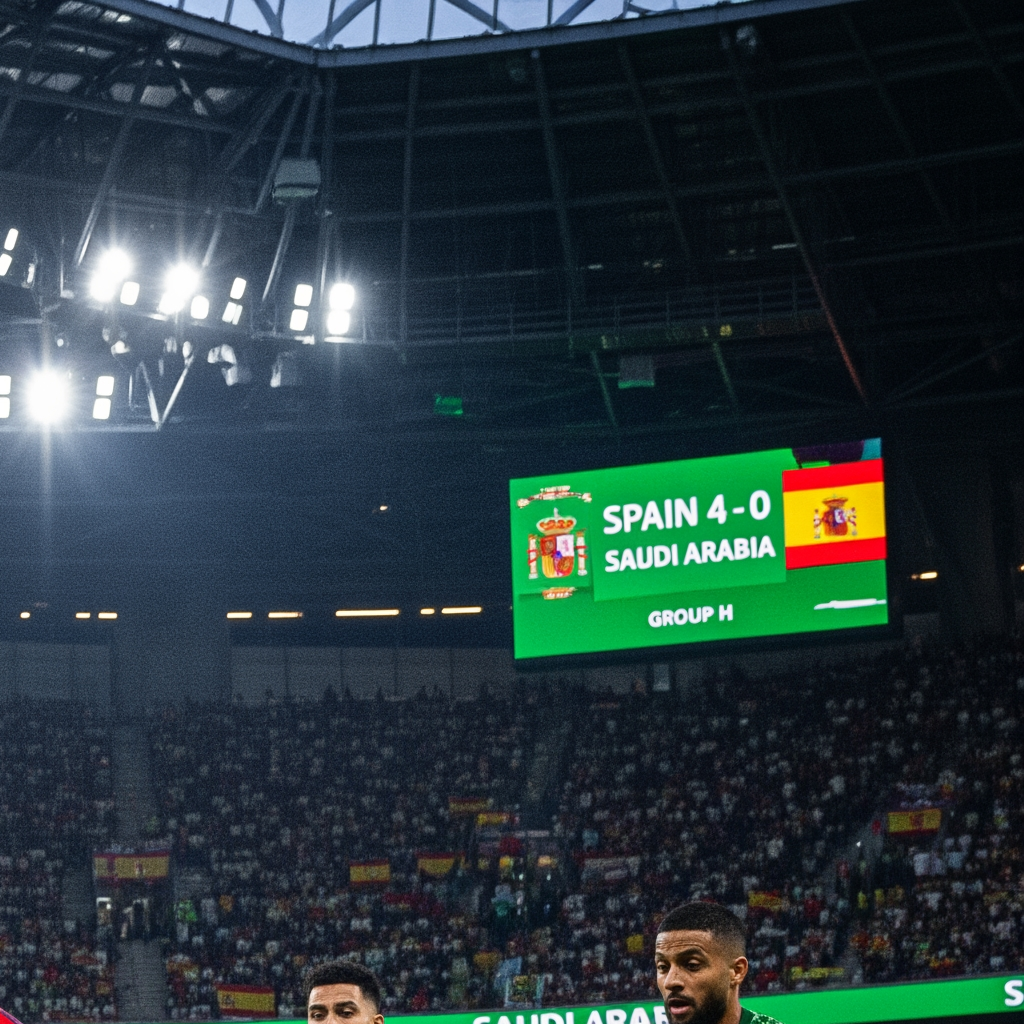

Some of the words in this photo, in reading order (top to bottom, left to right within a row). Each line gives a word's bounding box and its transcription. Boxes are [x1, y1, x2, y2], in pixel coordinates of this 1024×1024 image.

[603, 496, 698, 534] SPAIN
[605, 545, 679, 573] SAUDI
[683, 535, 776, 566] ARABIA
[647, 606, 715, 628] GROUP
[718, 603, 734, 621] H
